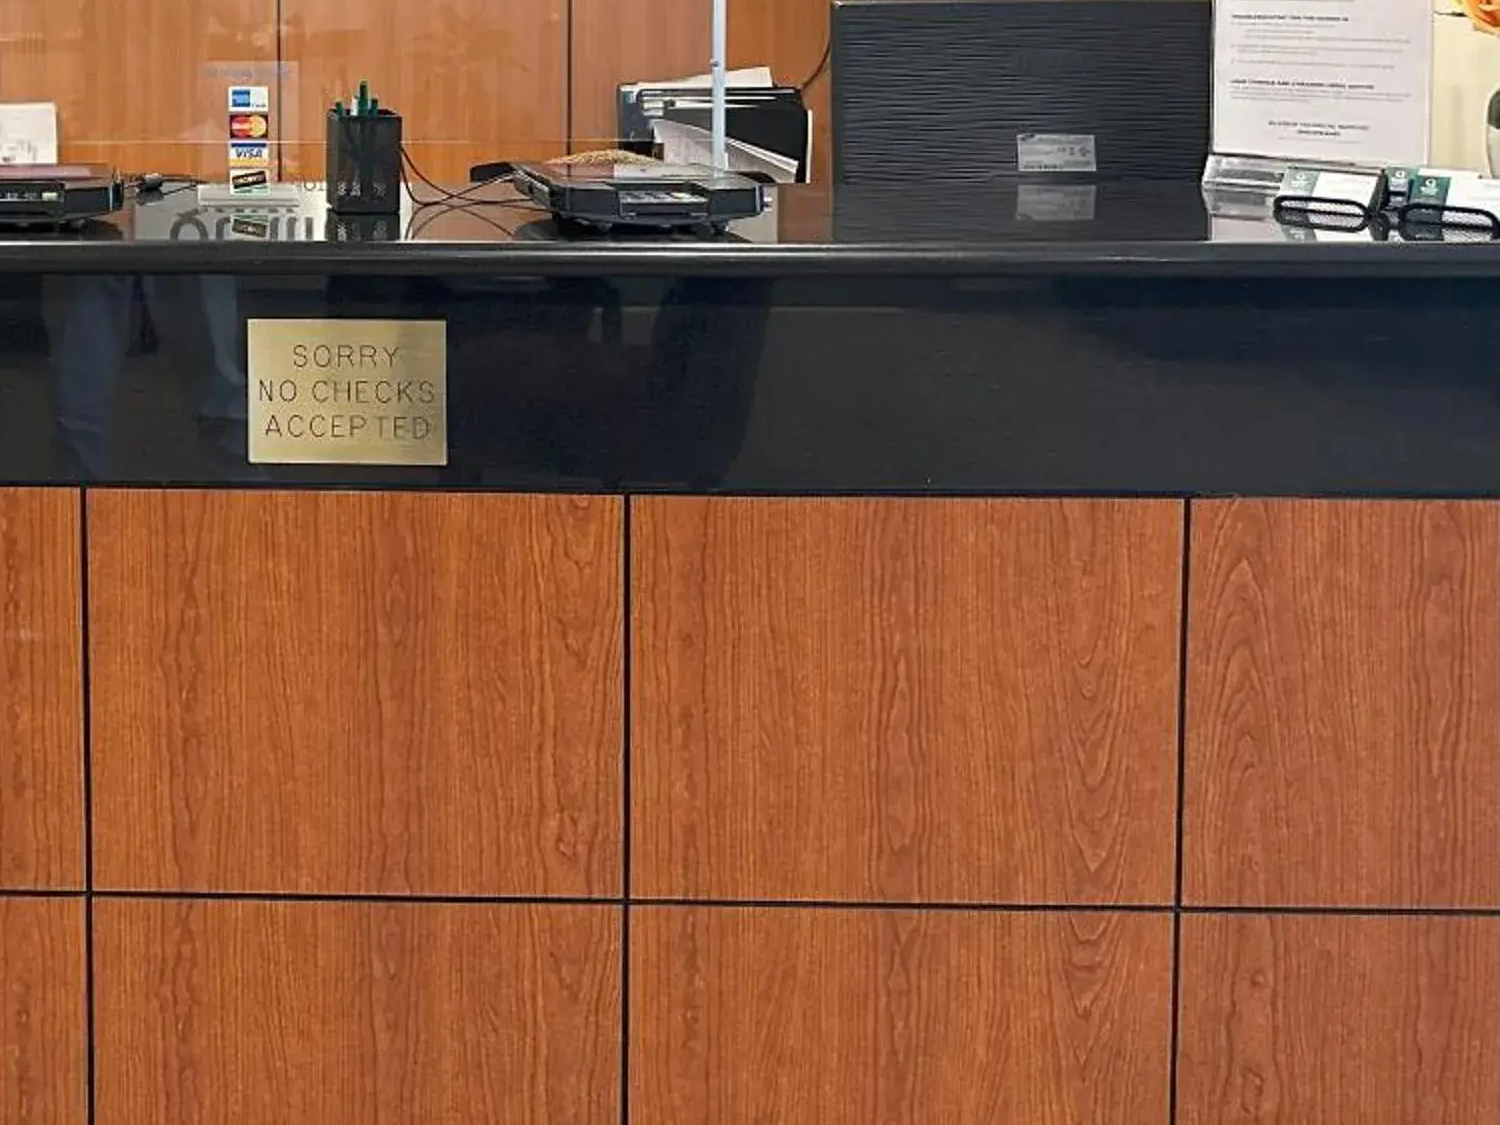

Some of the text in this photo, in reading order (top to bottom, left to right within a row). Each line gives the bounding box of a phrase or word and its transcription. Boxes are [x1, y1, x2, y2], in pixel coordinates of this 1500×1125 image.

[235, 147, 263, 159] VISA
[292, 344, 400, 368] SORRY
[258, 379, 436, 404] NO CHECKS
[265, 414, 429, 440] ACCEPTED
